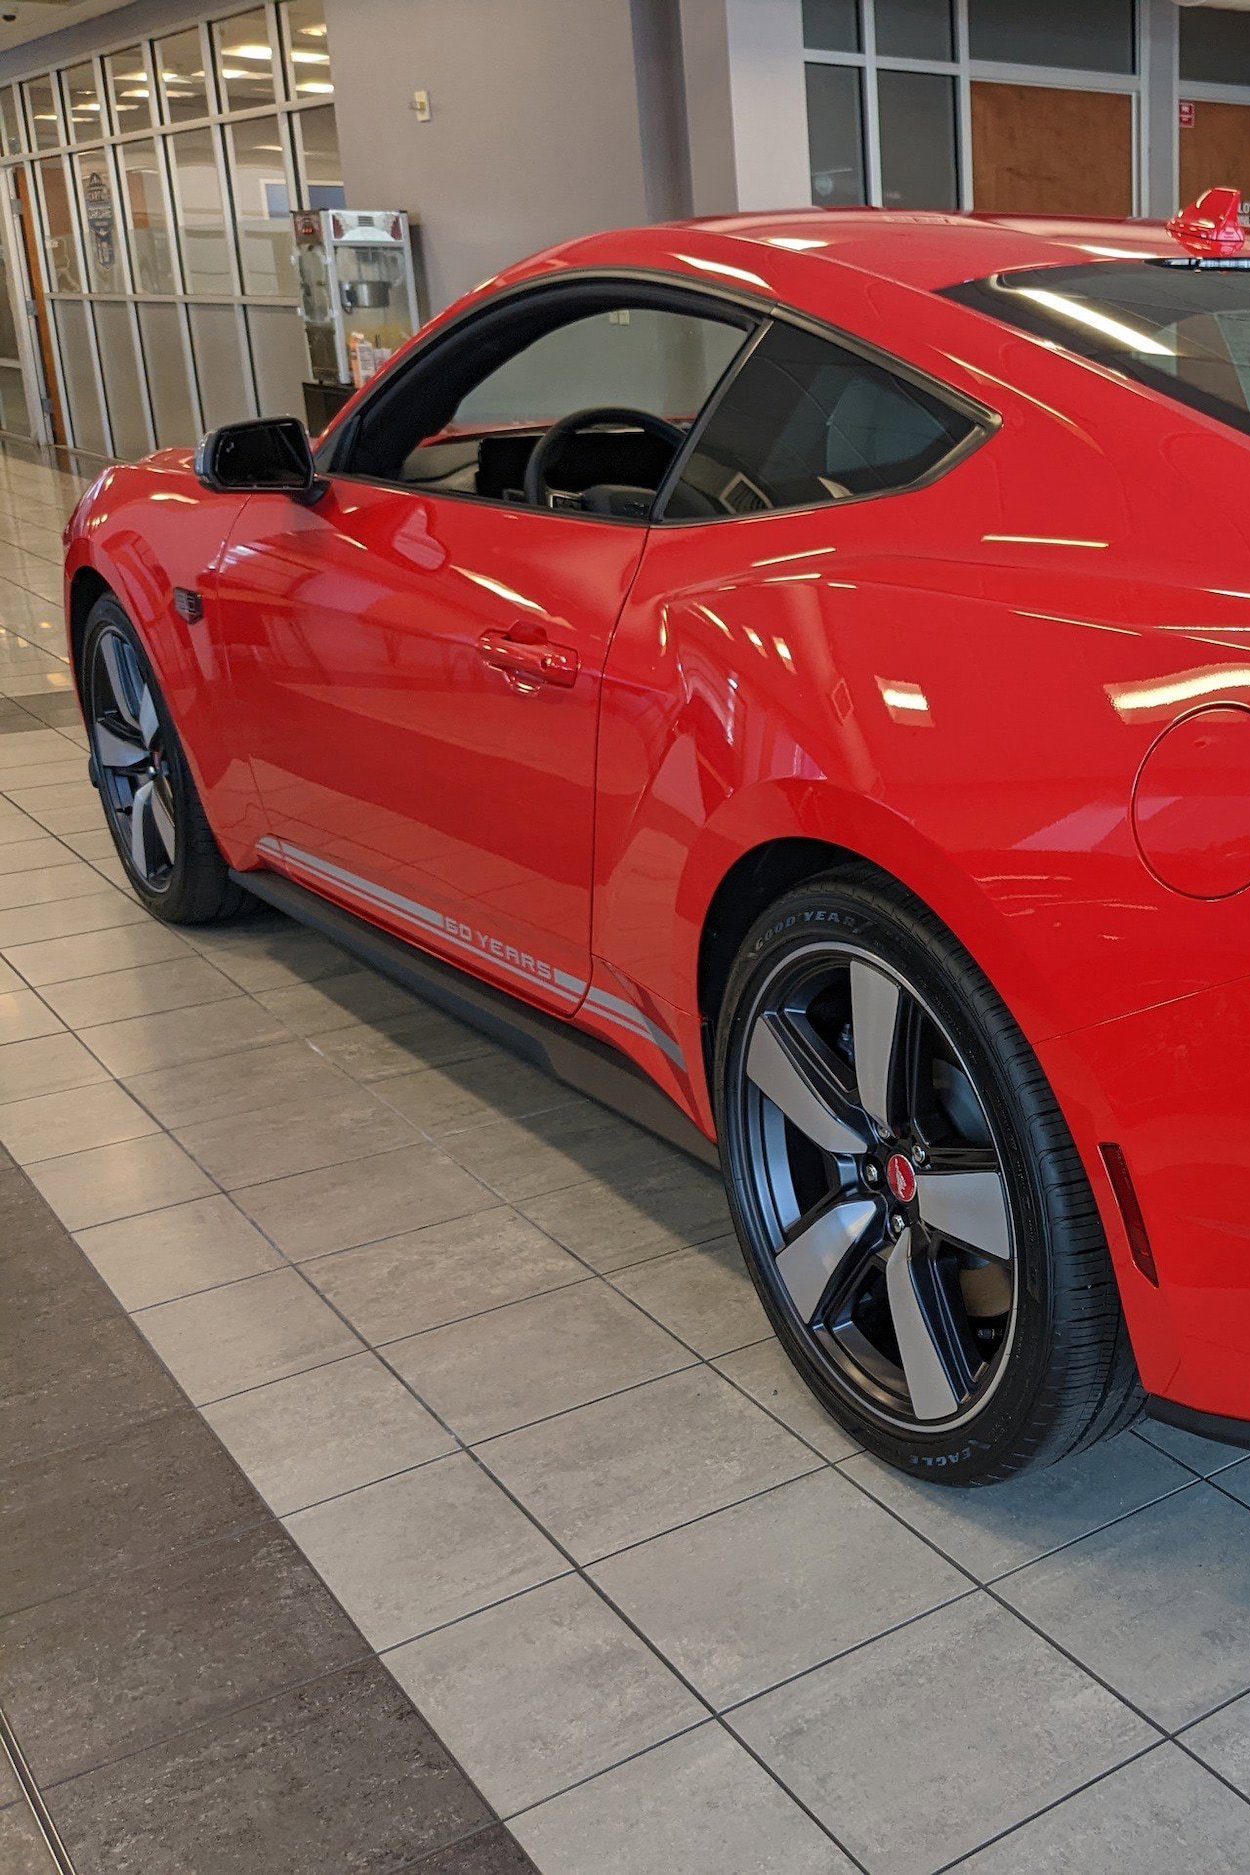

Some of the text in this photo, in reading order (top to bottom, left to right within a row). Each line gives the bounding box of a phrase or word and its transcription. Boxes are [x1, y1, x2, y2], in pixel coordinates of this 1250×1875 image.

[445, 917, 552, 979] 60 YEARS
[911, 1447, 971, 1468] EAGLE
